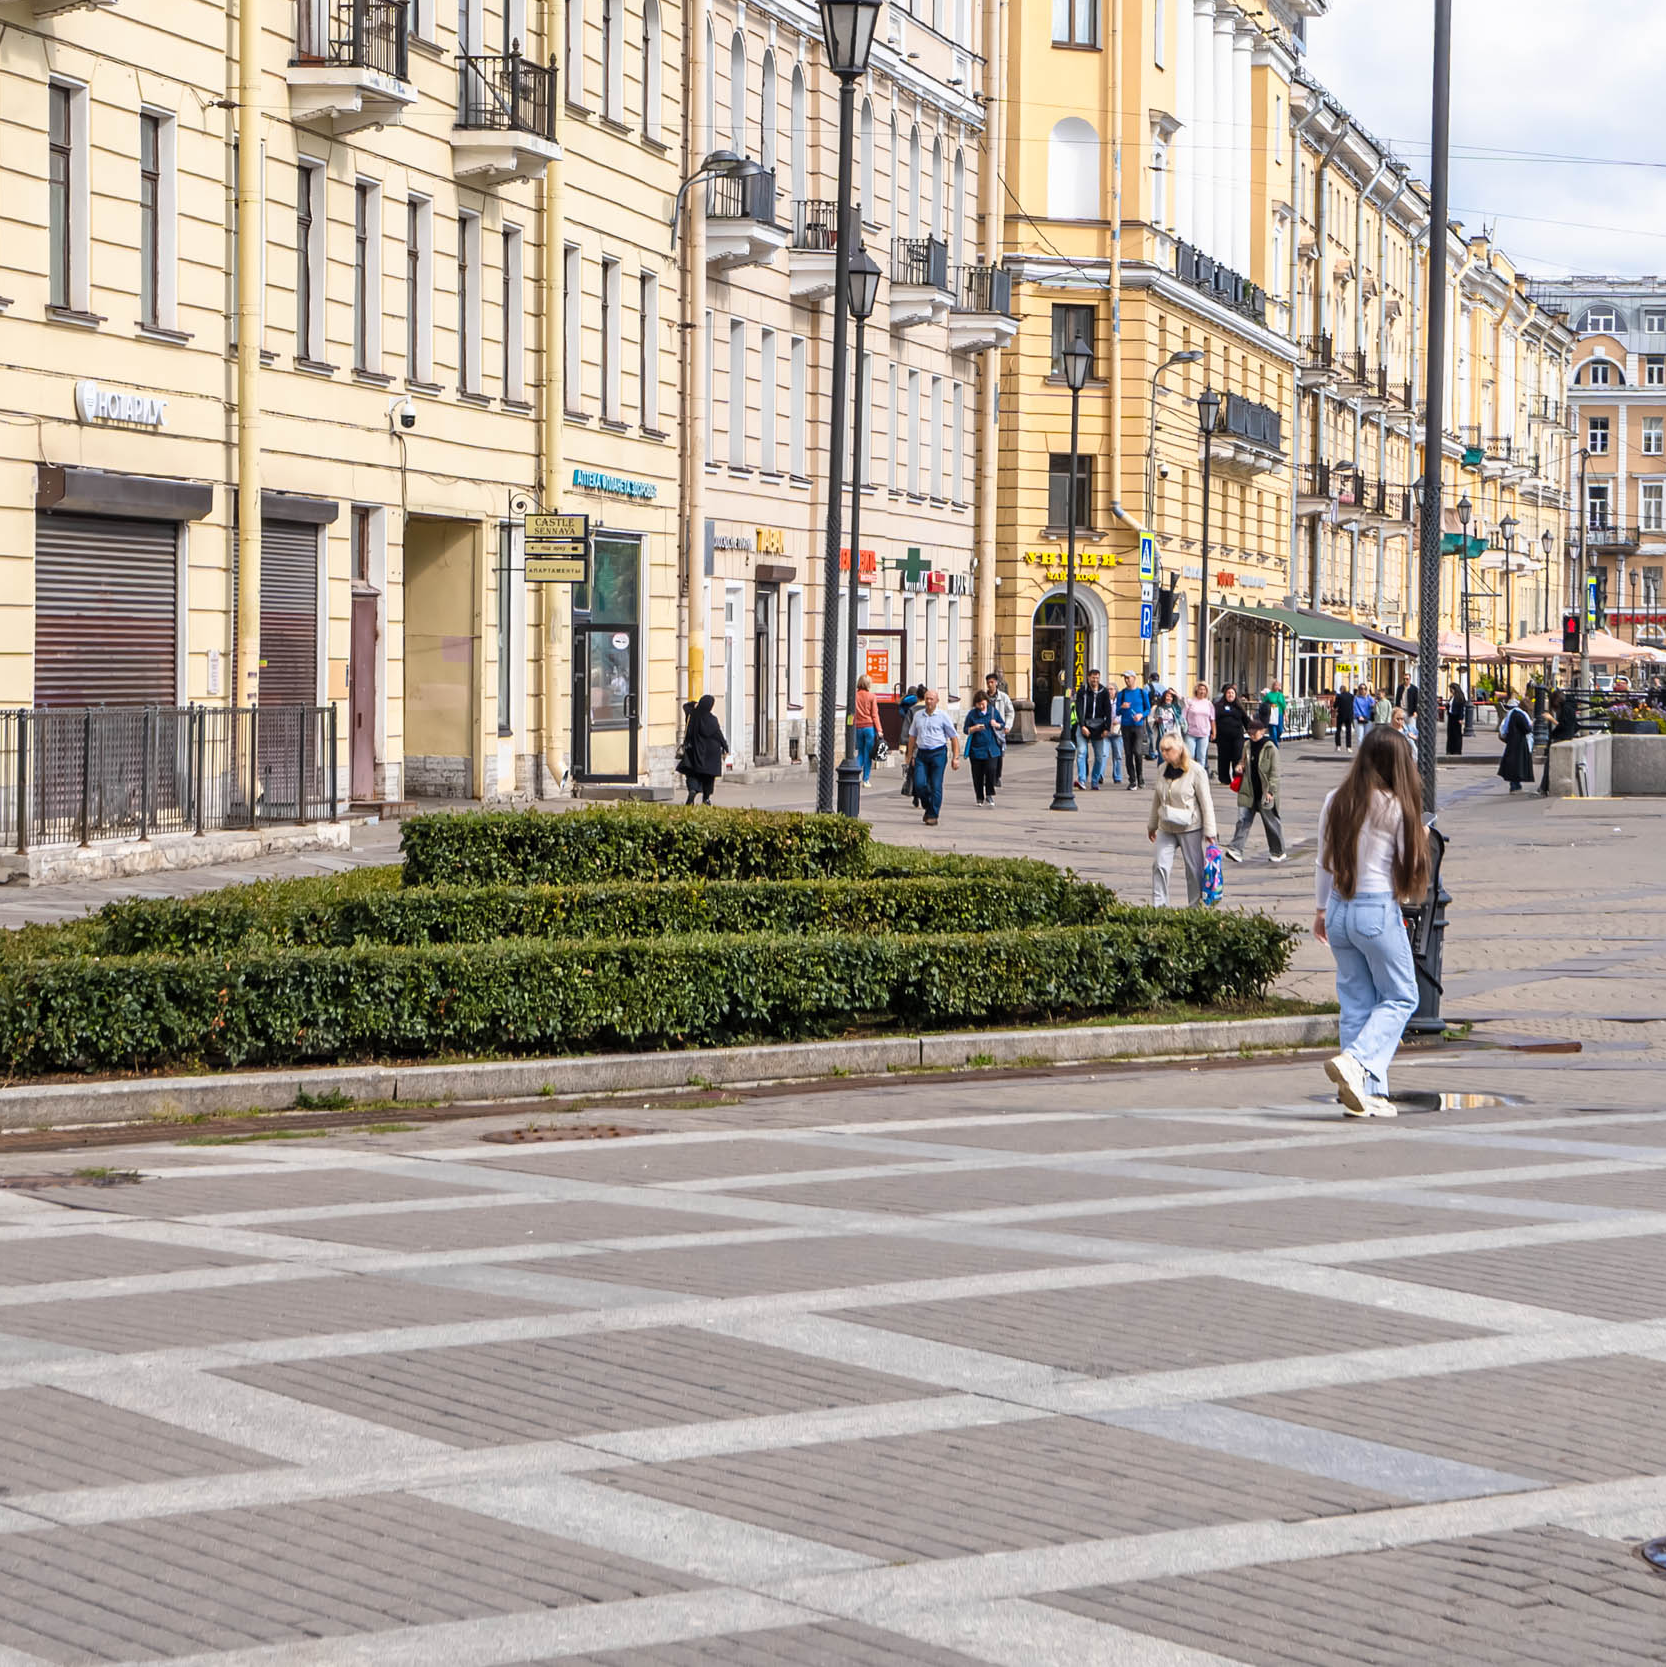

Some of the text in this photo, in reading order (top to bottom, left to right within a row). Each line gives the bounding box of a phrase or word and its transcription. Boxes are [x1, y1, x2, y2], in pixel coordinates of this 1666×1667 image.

[96, 391, 169, 427] НОТАРИУС
[576, 469, 602, 490] АПТЕКА
[535, 518, 574, 527] CASTLE
[534, 527, 575, 535] SENNAYA
